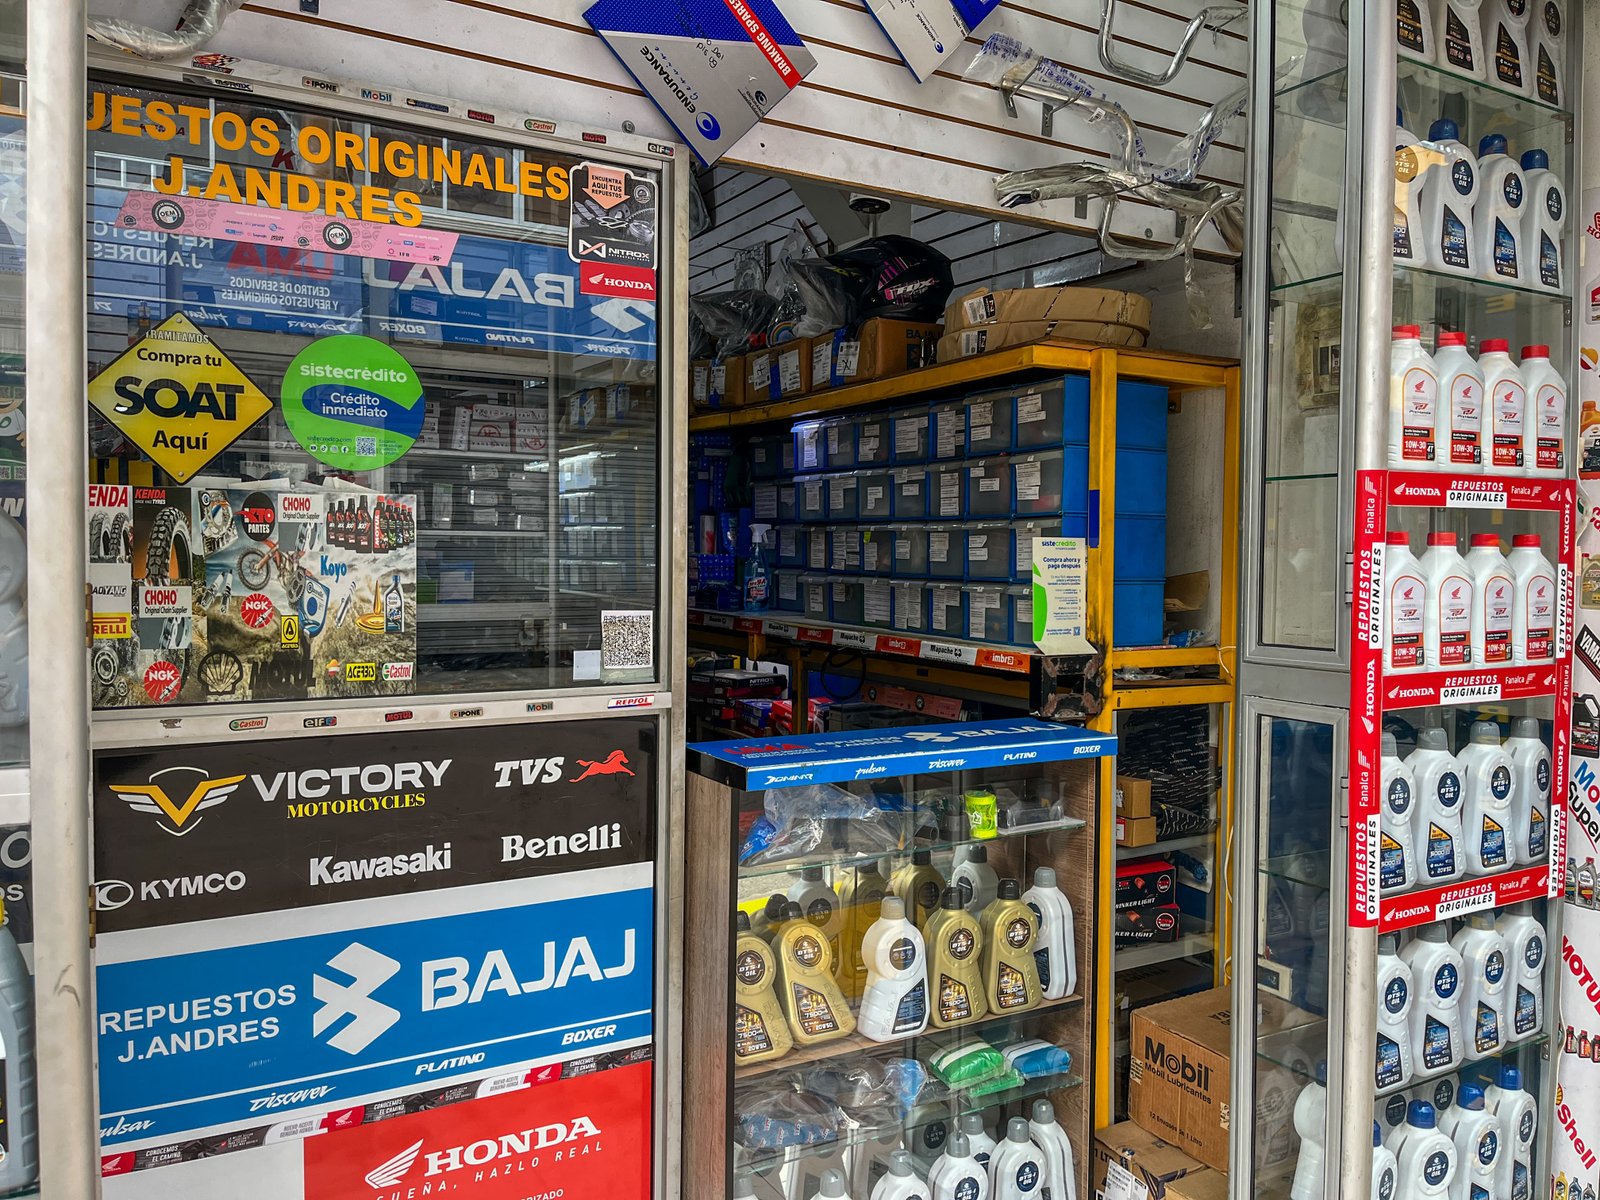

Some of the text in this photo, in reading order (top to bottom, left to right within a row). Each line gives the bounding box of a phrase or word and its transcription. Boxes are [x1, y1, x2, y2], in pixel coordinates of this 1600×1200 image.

[757, 32, 792, 77] BRAKING
[640, 45, 697, 114] ENDURANCE
[311, 80, 337, 92] IPONE
[361, 89, 392, 102] Mobil
[468, 111, 494, 122] MOTUL
[532, 121, 553, 132] Castrol
[649, 143, 665, 154] elf
[298, 126, 570, 200] ORIGINALES
[591, 174, 622, 185] ENCUENTRA
[1454, 173, 1471, 182] DTS-i
[152, 156, 424, 227] J.ANDRES
[591, 188, 622, 199] REPUESTOS
[610, 183, 622, 193] TUS
[160, 210, 177, 218] OEM
[329, 232, 345, 240] OEM
[608, 247, 650, 259] NITROX
[604, 277, 653, 291] HONDA
[137, 348, 222, 367] Compra tu
[300, 362, 408, 383] sistecrédito
[114, 376, 244, 421] SOAT
[330, 392, 380, 406] Crédito
[322, 403, 388, 418] inmediato
[152, 430, 208, 454] Aquí
[1405, 440, 1427, 449] 10W-30
[1427, 445, 1434, 453] 4T
[1453, 444, 1473, 453] 10W-30
[1495, 447, 1516, 456] 10W-30
[1451, 480, 1503, 491] REPUESTOS
[1511, 486, 1531, 495] Fanalca
[135, 488, 166, 499] KENDA
[1405, 487, 1441, 497] HONDA
[1449, 492, 1504, 503] ORIGINALES
[282, 496, 311, 511] CHOHO
[283, 513, 296, 521] Original
[305, 513, 320, 521] Supplier
[1364, 497, 1374, 534] Fanalca
[248, 524, 270, 534] PARTES
[320, 555, 347, 583] Koyo
[1060, 562, 1081, 570] después
[144, 590, 178, 606] CHOHO
[1358, 550, 1371, 642] REPUESTOS
[1371, 547, 1382, 644] ORIGINALES
[145, 606, 188, 615] Original Chain Supplier
[245, 600, 269, 610] NGK
[840, 632, 860, 643] Mapache
[930, 644, 954, 655] Mapache
[1394, 648, 1415, 657] 10W-30
[991, 653, 1015, 665] imbra
[148, 670, 175, 681] NGK
[347, 664, 375, 678] ACERBIS
[389, 663, 411, 679] Castrol
[1445, 674, 1498, 687] REPUESTOS
[1505, 675, 1525, 684] Fanalca
[1366, 659, 1376, 717] HONDA
[1399, 687, 1435, 698] HONDA
[1443, 686, 1498, 698] ORIGINALES
[527, 702, 553, 712] Mobil
[615, 696, 648, 706] REPSOL
[386, 711, 412, 721] MOTUL
[458, 709, 481, 718] IPONE
[239, 719, 264, 729] Castrol
[304, 717, 325, 727] elf
[952, 724, 1068, 738] BAJAJ
[1003, 751, 1037, 761] PLATINO
[1073, 745, 1101, 755] BOXER
[928, 758, 968, 770] Discover
[494, 757, 565, 788] TVS
[855, 763, 888, 780] pulsar
[1556, 745, 1564, 796] HONDA
[250, 758, 452, 803] VICTORY
[1359, 771, 1369, 807] Fanalca
[287, 793, 425, 819] MOTORCYCLES
[501, 823, 622, 862] Benelli
[1551, 809, 1560, 894] ORIGINALES
[1558, 810, 1566, 890] REPUESTOS
[310, 842, 451, 886] Kawasaki
[1355, 822, 1367, 913] REPUESTOS
[1368, 820, 1377, 915] ORIGINALES
[140, 870, 246, 901] KYMCO
[1499, 881, 1519, 891] Fanalca
[1440, 882, 1493, 902] REPUESTOS
[1138, 898, 1156, 906] LIGHT
[1438, 893, 1493, 914] ORIGINALES
[1395, 905, 1430, 920] HONDA
[804, 952, 814, 960] OIL
[421, 928, 636, 1012] BAJAJ
[745, 969, 757, 977] OIL
[1437, 976, 1455, 986] DTS-i
[100, 984, 296, 1035] REPUESTOS
[117, 1017, 280, 1063] J.ANDRES
[561, 1024, 617, 1046] BOXER
[1433, 1039, 1448, 1048] 5000
[415, 1052, 485, 1075] PLATINO
[1145, 1035, 1209, 1092] Mobil
[1144, 1062, 1212, 1105] Mobil Lubricantes
[250, 1084, 337, 1112] Discover
[373, 1099, 403, 1111] CONOCEMOS
[386, 1104, 405, 1115] CAMINO
[1557, 1107, 1597, 1170] Shell
[145, 1145, 179, 1157] CONOCEMOS
[424, 1116, 602, 1177] HONDA
[152, 1151, 181, 1162] EL CAMINO
[475, 1141, 602, 1183] HAZLO REAL
